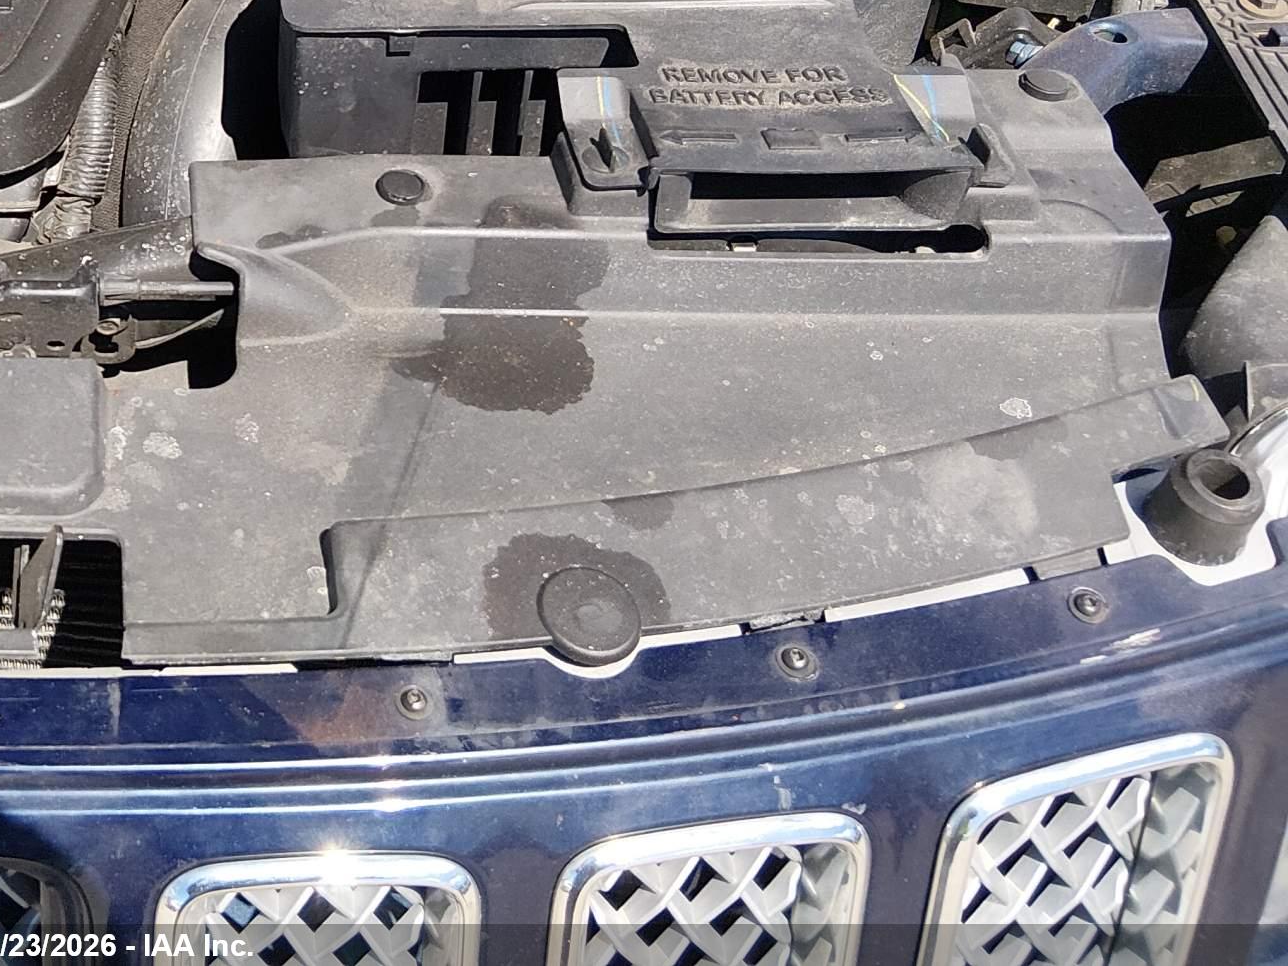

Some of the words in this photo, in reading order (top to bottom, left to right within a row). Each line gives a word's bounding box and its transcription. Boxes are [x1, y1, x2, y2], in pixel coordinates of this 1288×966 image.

[660, 66, 779, 84] REMOVE
[784, 65, 848, 83] FOR
[648, 87, 766, 106] BATTERY
[777, 86, 889, 106] ACCESS
